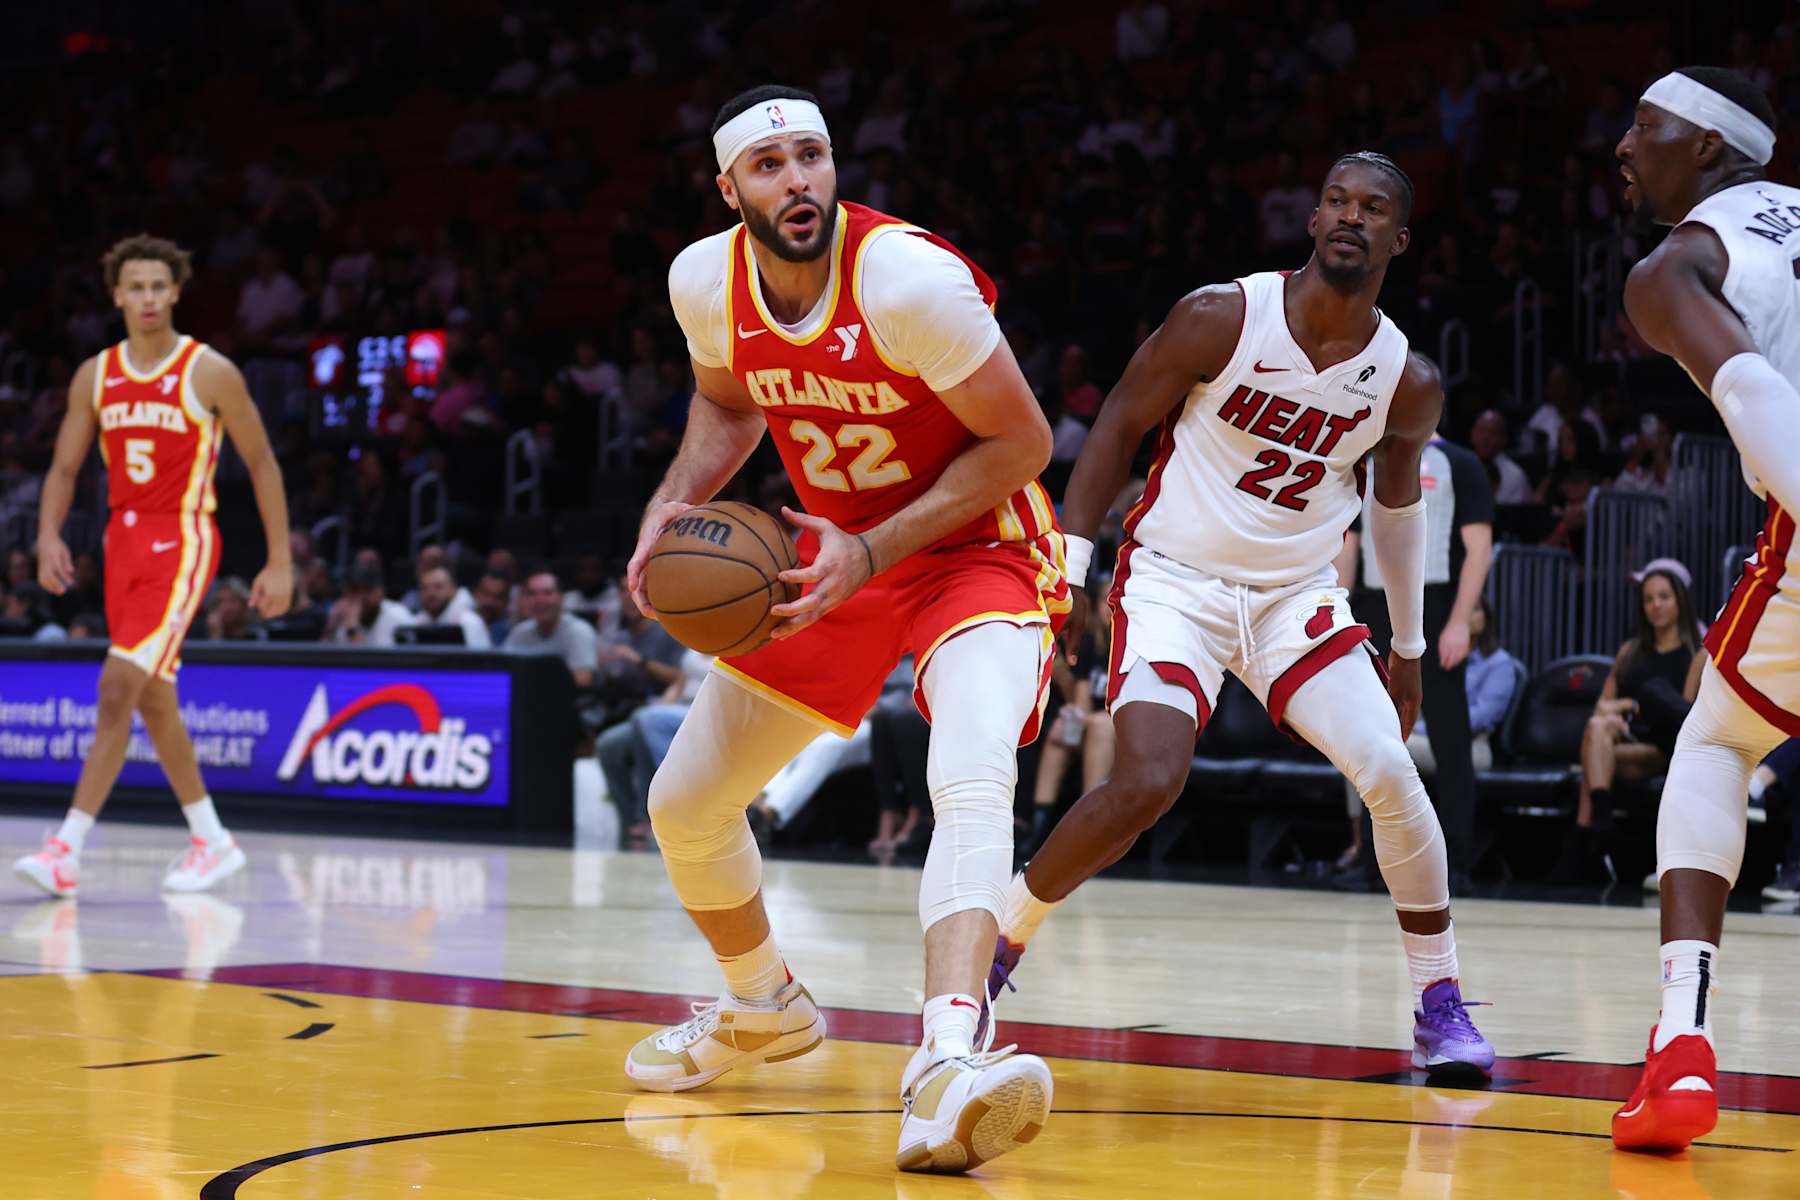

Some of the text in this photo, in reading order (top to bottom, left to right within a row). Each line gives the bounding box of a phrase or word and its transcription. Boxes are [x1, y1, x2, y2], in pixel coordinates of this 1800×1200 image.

[825, 344, 840, 353] the
[833, 322, 862, 362] Y
[745, 367, 911, 416] ATLANTA
[1342, 383, 1378, 401] Robinhood
[100, 400, 189, 434] ATLANTA
[1217, 384, 1372, 458] HEAT
[124, 437, 156, 485] 5
[788, 418, 913, 493] 22
[1235, 447, 1327, 513] 22
[49, 728, 76, 761] of
[277, 682, 492, 789] Acordis
